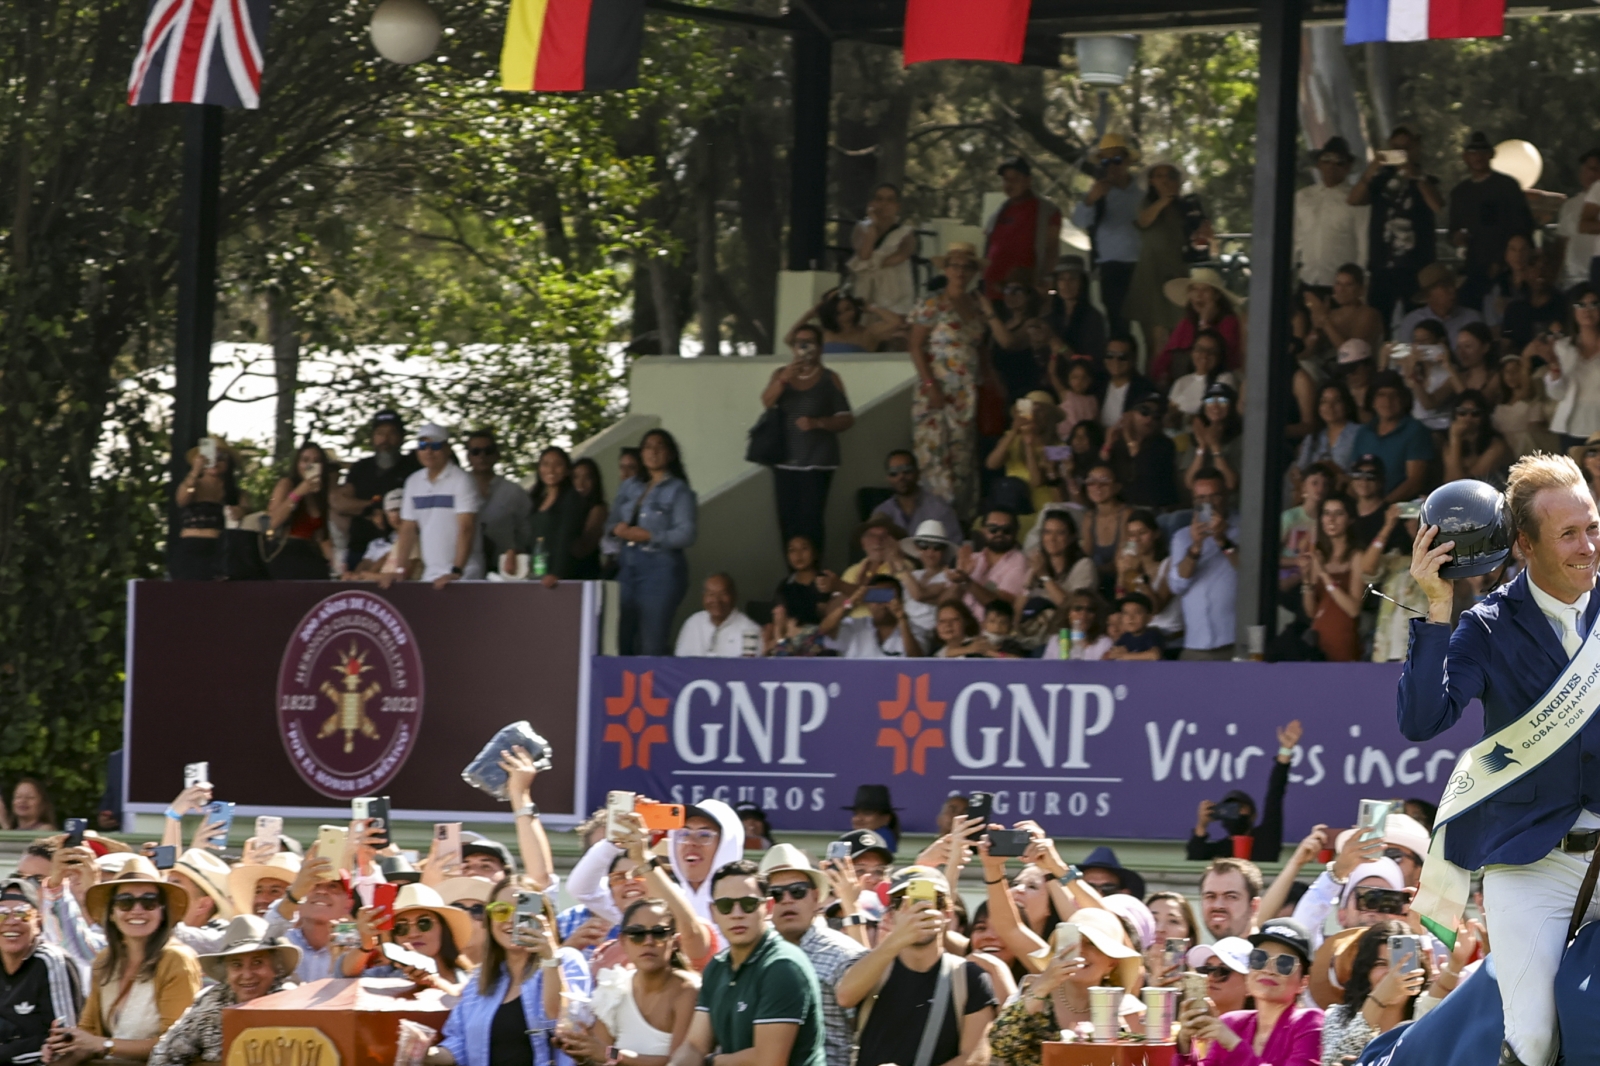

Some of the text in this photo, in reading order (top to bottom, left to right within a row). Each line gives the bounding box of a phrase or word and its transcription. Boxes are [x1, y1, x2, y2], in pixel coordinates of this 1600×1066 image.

[281, 695, 317, 711] 1823
[380, 697, 418, 712] 2023
[1528, 672, 1582, 729] LONGINES
[672, 679, 829, 765] GNP
[950, 681, 1115, 769] GNP
[1564, 708, 1585, 729] TOUR
[1522, 720, 1558, 749] GLOBAL
[1145, 719, 1265, 783] Vivir
[671, 784, 825, 811] SEGUROS
[948, 790, 1111, 817] GUROS
